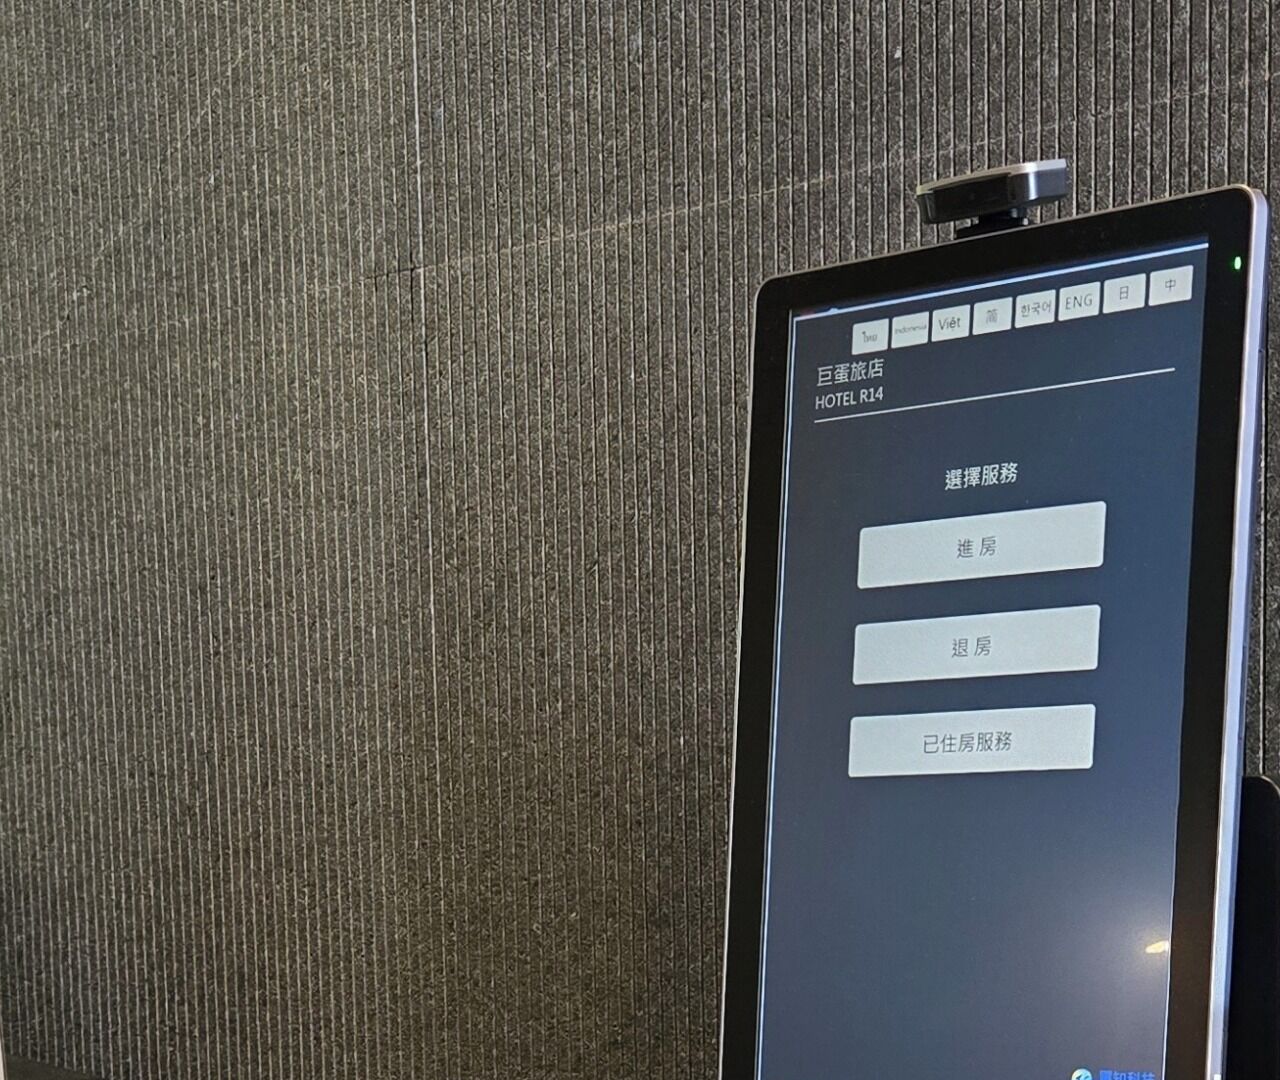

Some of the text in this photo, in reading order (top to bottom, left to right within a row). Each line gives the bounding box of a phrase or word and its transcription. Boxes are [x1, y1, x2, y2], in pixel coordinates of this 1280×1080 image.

[1119, 285, 1129, 300] 日
[1165, 278, 1176, 291] 中
[1020, 300, 1052, 317] 한국어
[1065, 293, 1093, 310] ENG
[938, 317, 961, 332] Việt
[816, 358, 885, 387] 巨蛋旅店
[815, 386, 884, 410] HOTEL R14
[944, 462, 1018, 490] 選擇服務
[922, 731, 1013, 754] 已住房服務
